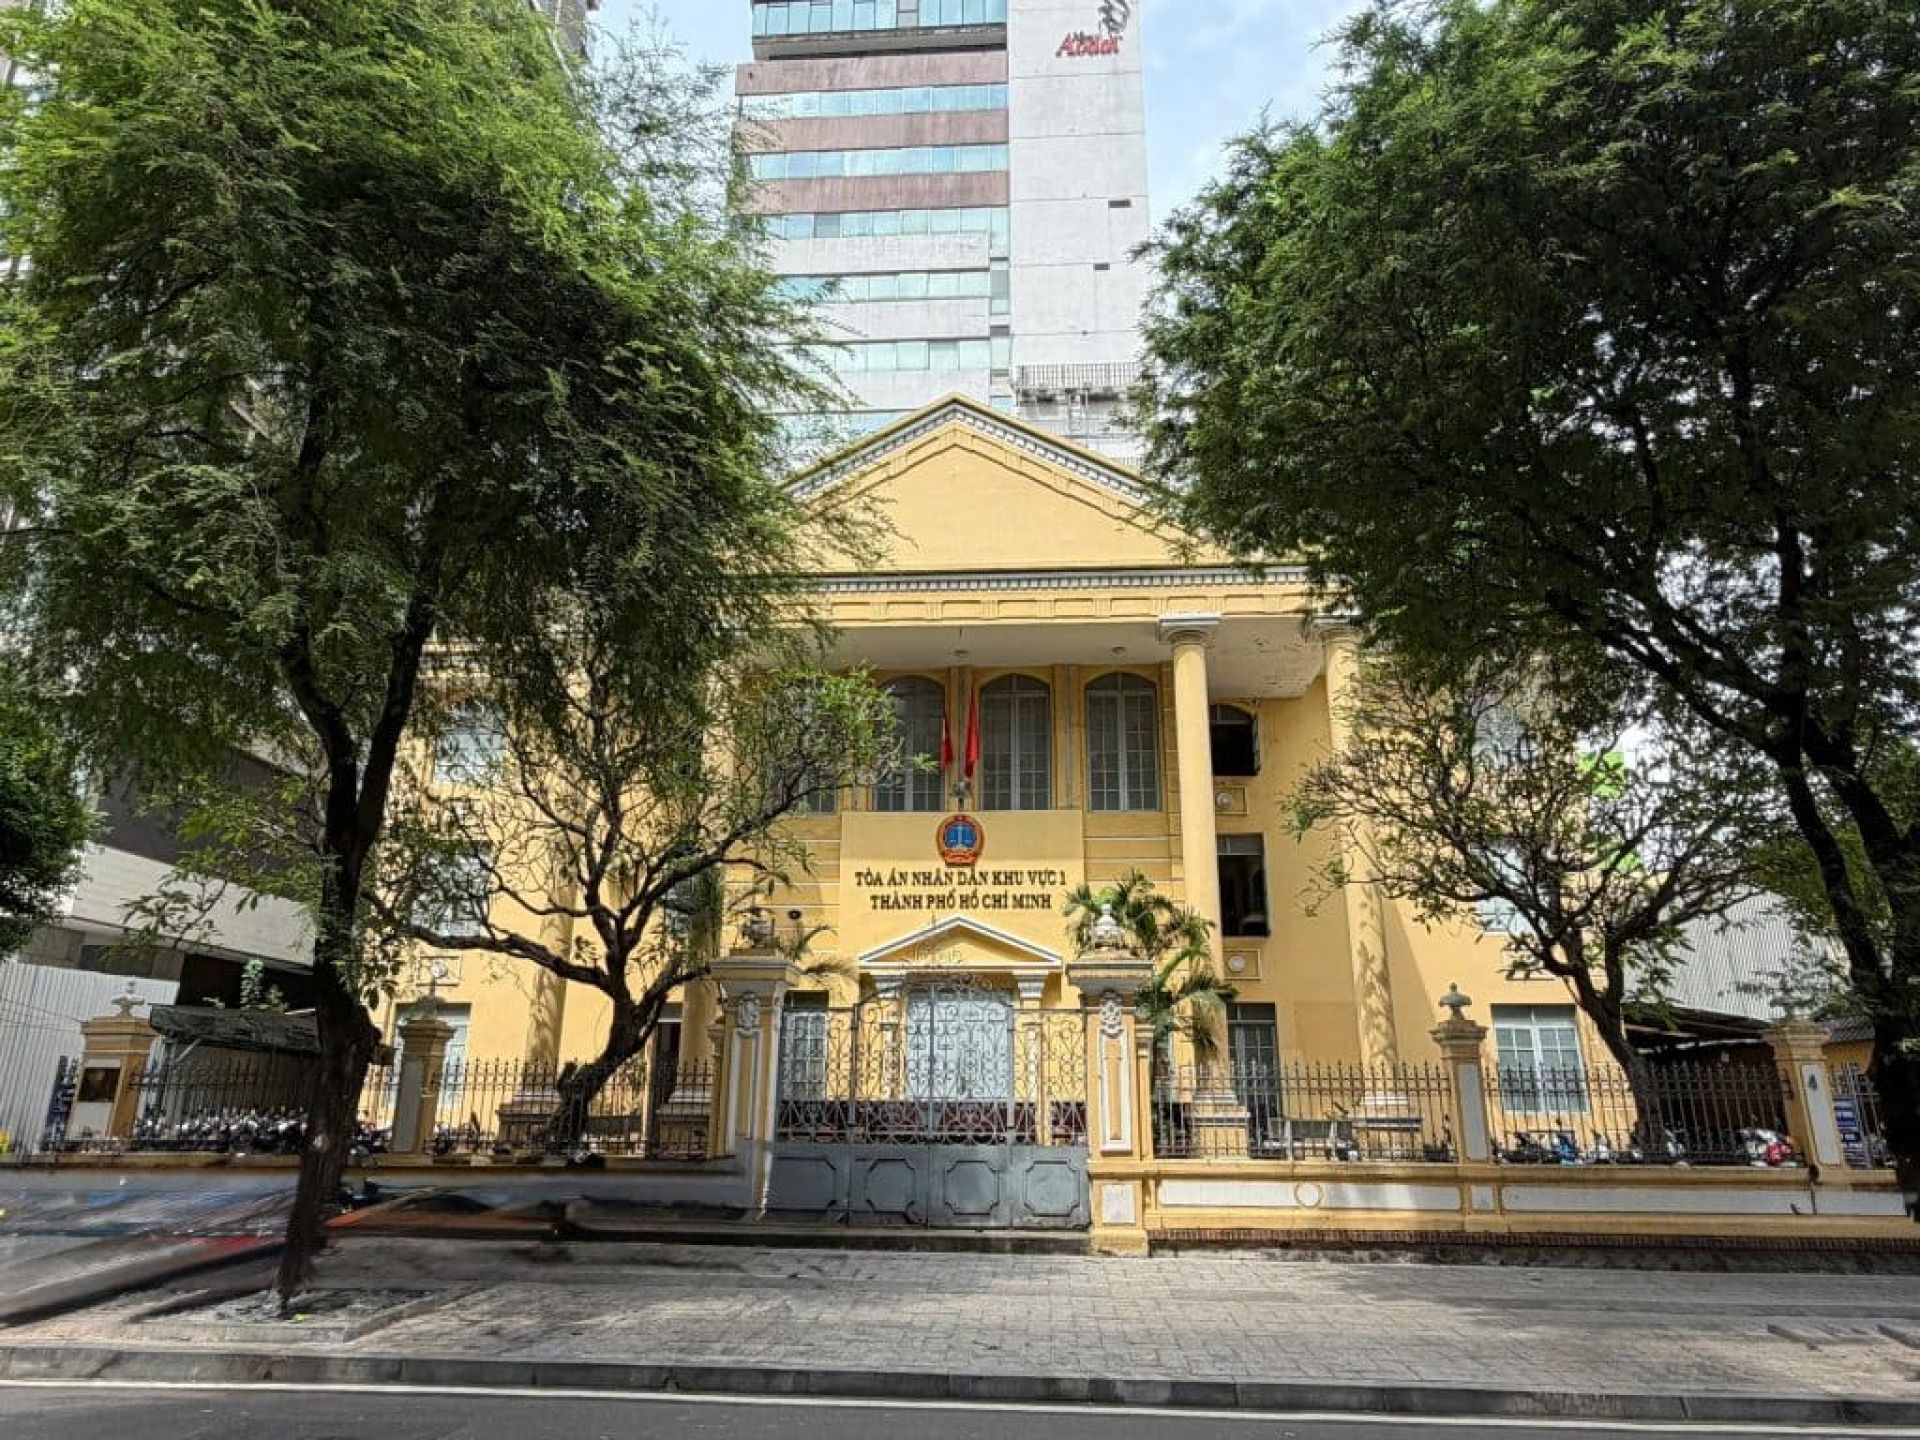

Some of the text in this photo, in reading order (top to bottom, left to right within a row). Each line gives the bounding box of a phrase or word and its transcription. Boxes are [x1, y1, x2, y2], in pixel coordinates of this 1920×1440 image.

[855, 867, 1067, 889] TÒA ÁN NHÂN DÂN KHU VỰC 1
[870, 888, 1052, 910] THÀNH PHỐ HỒ CHÍ MINH
